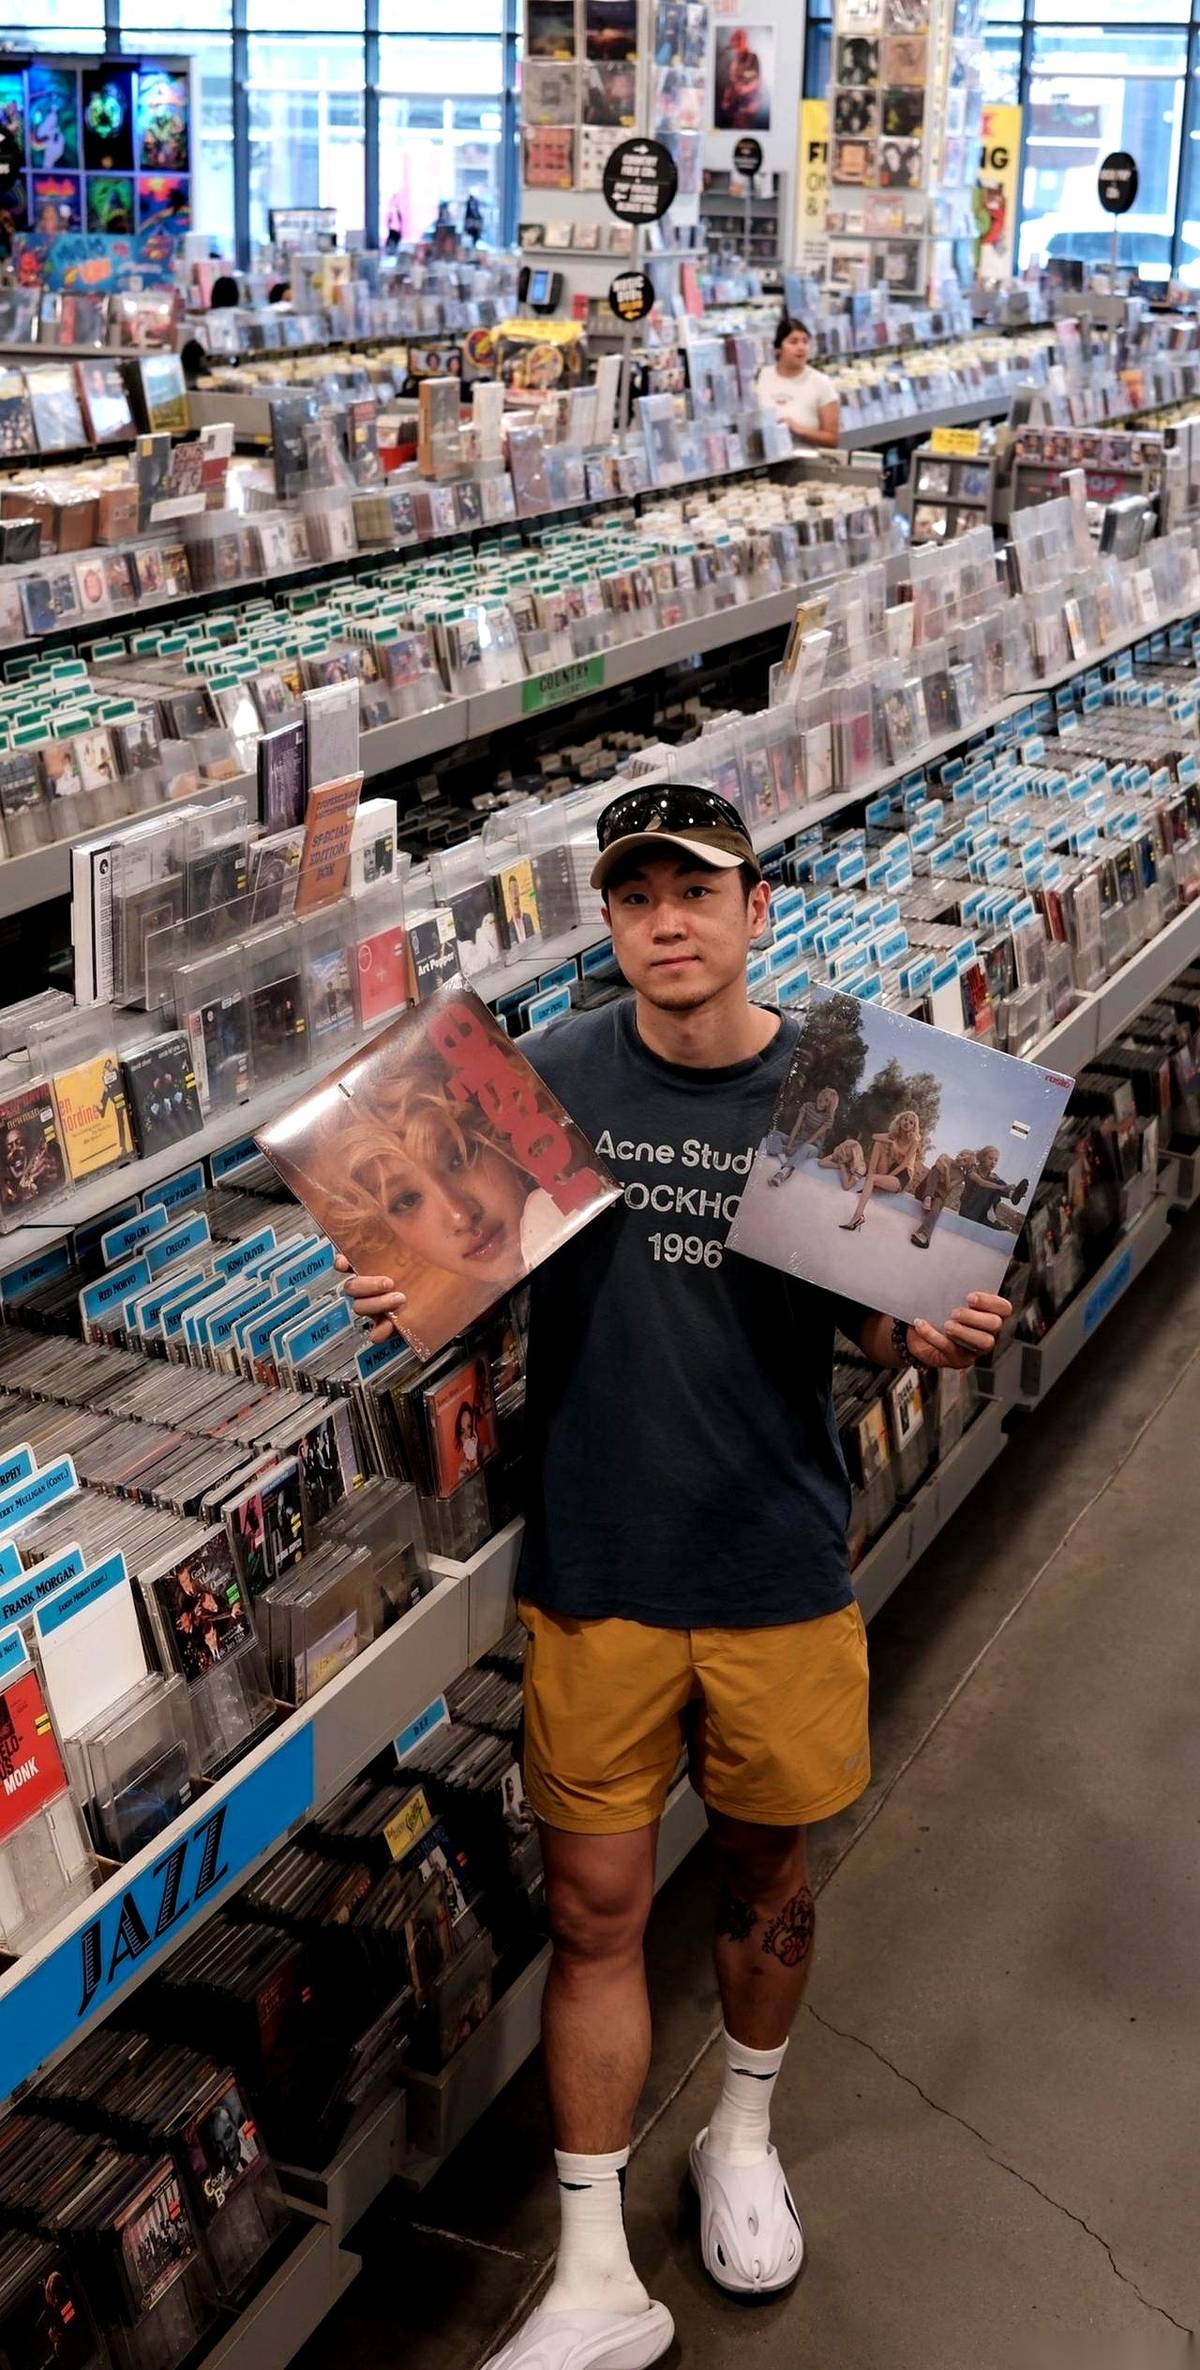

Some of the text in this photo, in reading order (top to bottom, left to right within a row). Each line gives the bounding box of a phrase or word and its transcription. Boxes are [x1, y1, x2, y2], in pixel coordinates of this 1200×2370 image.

[539, 662, 589, 692] COUNTRY
[418, 962, 430, 977] Art
[594, 1130, 759, 1175] Acne Stud
[165, 1234, 191, 1256] OREGON
[648, 1232, 724, 1269] 1996
[0, 1464, 22, 1487] RPHY
[2, 1591, 36, 1620] FRANK
[35, 1564, 77, 1598] MORGAN
[3, 1756, 40, 1796] MONK
[77, 1804, 229, 2017] JAZZ
